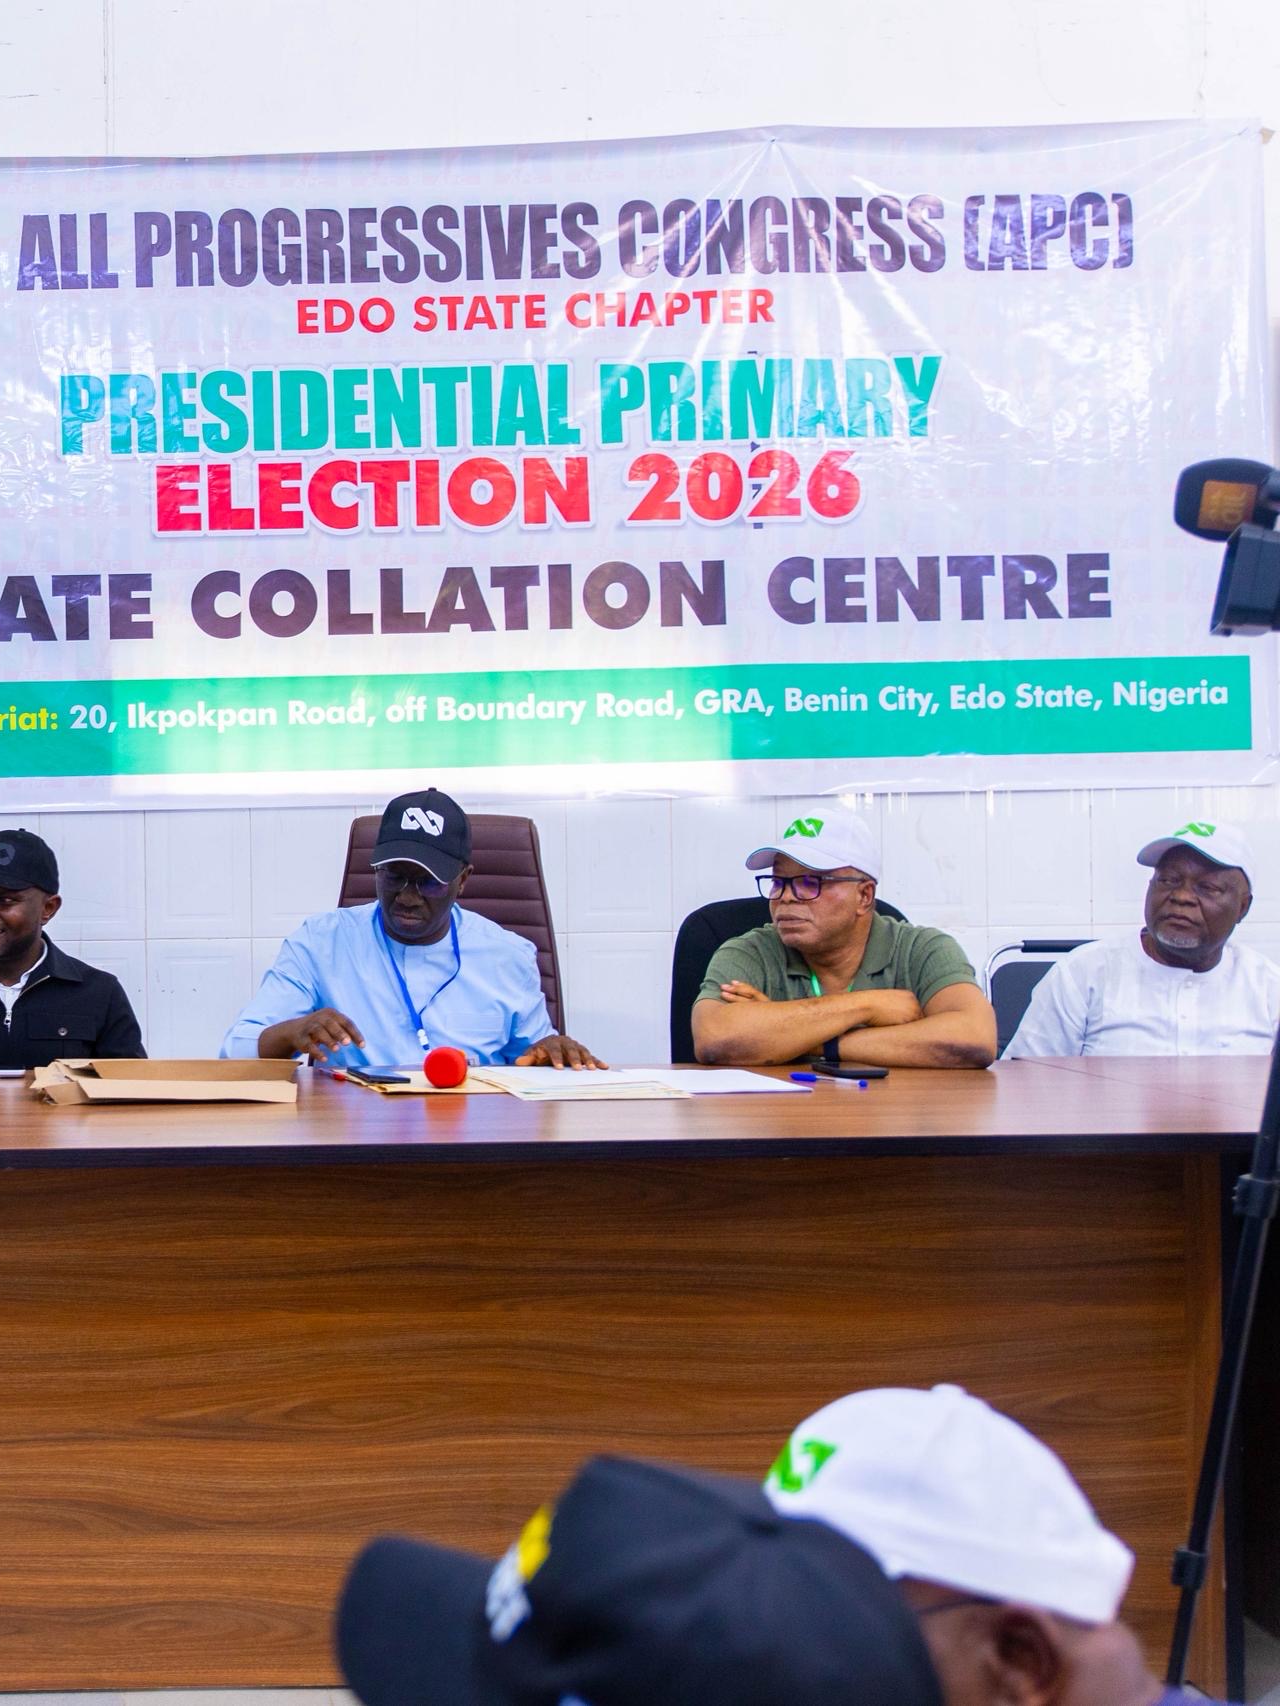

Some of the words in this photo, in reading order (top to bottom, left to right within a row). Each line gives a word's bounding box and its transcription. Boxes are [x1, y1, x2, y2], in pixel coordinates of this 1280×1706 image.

[18, 212, 118, 291] ALL
[134, 202, 602, 288] PROGRESSIVES
[618, 195, 946, 278] CONGRESS
[297, 298, 398, 334] EDO
[413, 294, 548, 332] STATE
[565, 288, 775, 329] CHAPTER
[61, 364, 581, 456] PRESIDENTIAL
[600, 355, 944, 444] PRIMARY
[156, 456, 592, 532] ELECTION
[626, 449, 862, 523] 2026
[191, 561, 727, 639] COLLATION
[767, 552, 1112, 625] CENTRE
[69, 704, 117, 733] 20,
[127, 701, 277, 735] Ikpokpan
[288, 701, 375, 729] Road,
[385, 699, 429, 723] off
[437, 691, 586, 726] Boundary
[595, 689, 685, 721] Road,
[694, 689, 774, 717] GRA,
[785, 687, 869, 712] Benin
[879, 683, 939, 717] City,
[949, 683, 1007, 711] Edo
[1016, 682, 1103, 711] State,
[1113, 679, 1229, 714] Nigeria
